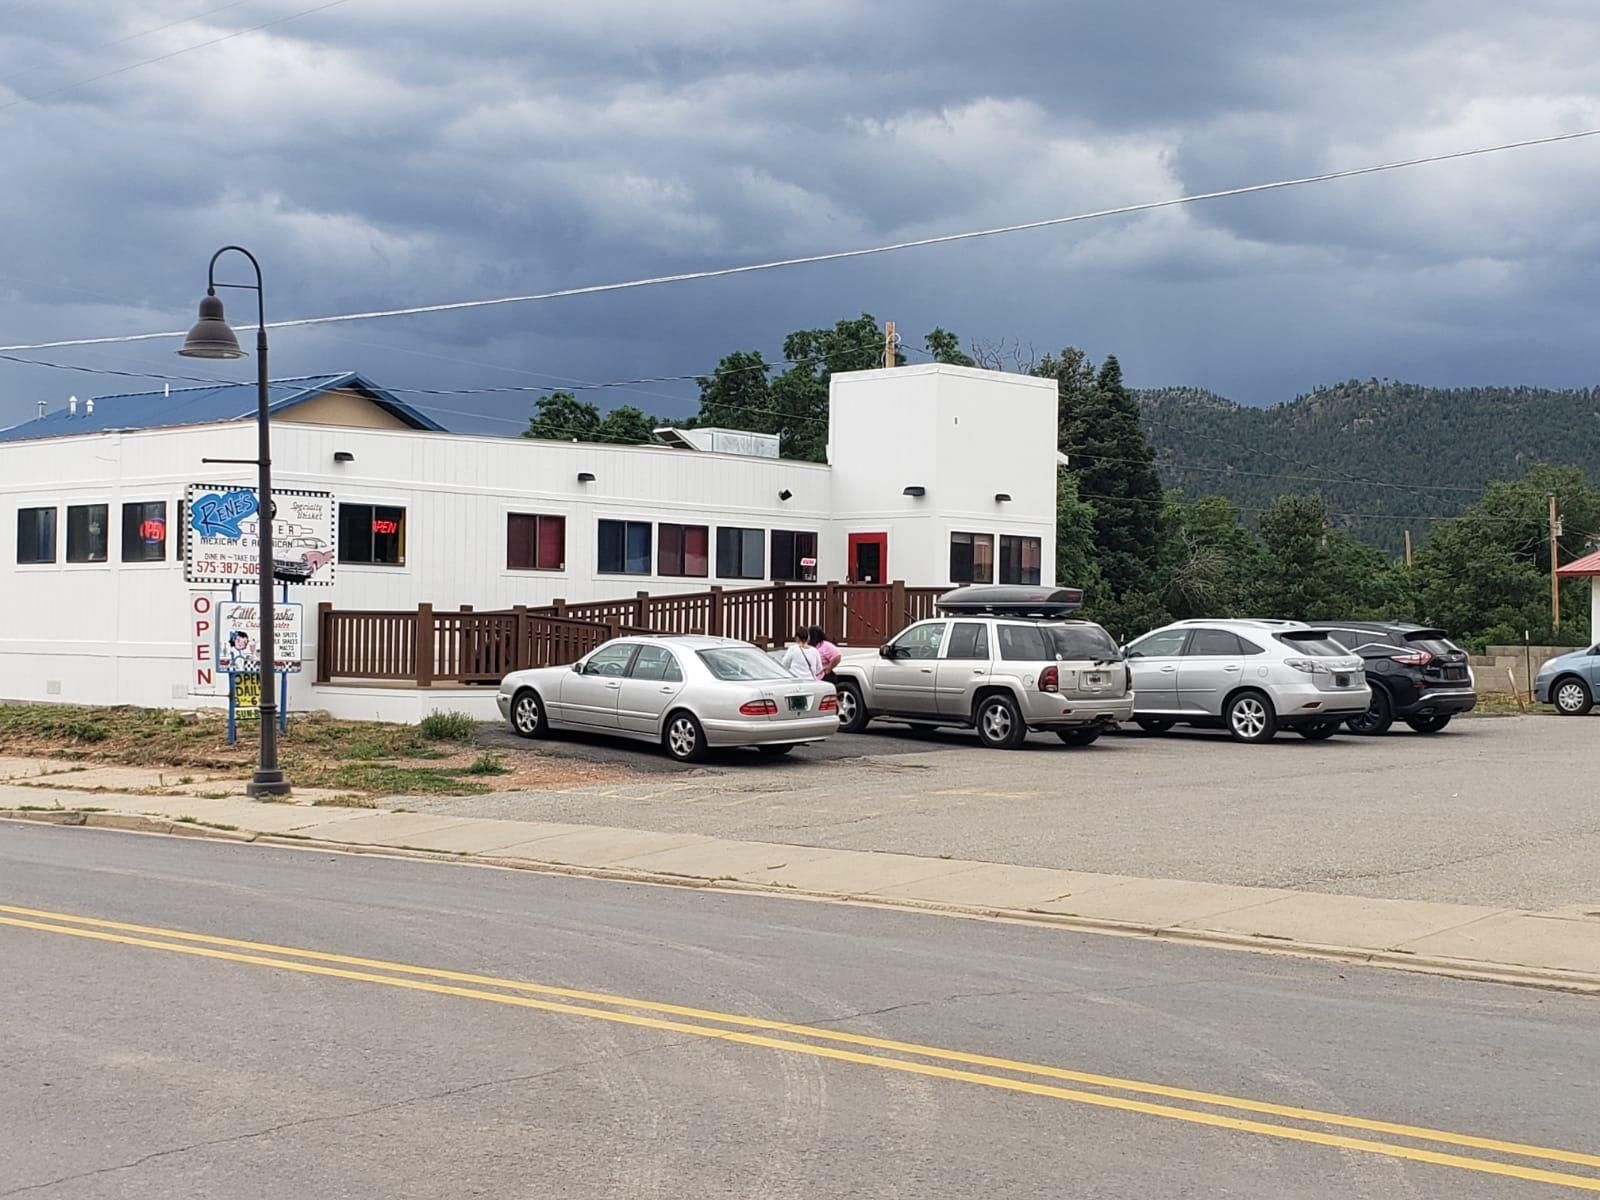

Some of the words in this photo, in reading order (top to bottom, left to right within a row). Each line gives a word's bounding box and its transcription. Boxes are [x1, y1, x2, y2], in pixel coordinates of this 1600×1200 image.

[200, 493, 254, 535] RENE'S
[249, 523, 294, 535] DER
[200, 536, 238, 547] MEXICAN
[252, 538, 293, 549] AICAN
[226, 605, 257, 620] Little
[258, 607, 295, 621] aska
[194, 597, 212, 685] OPEN
